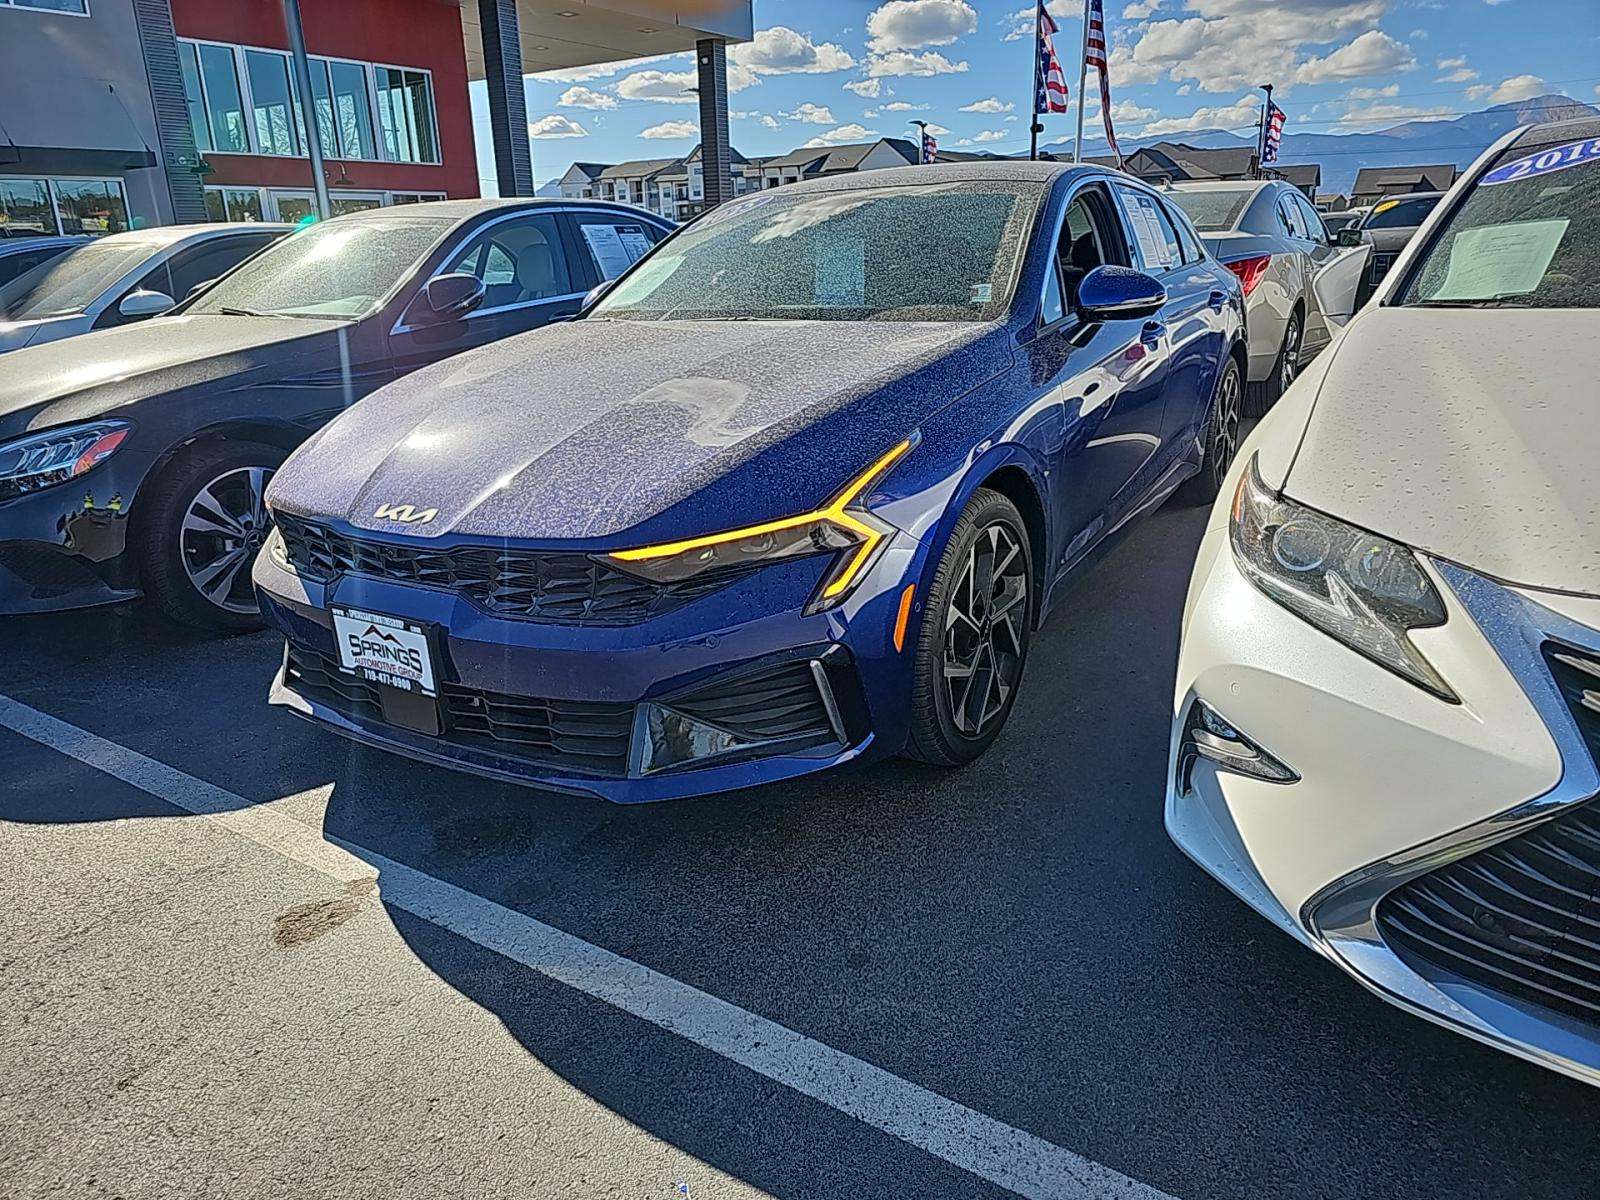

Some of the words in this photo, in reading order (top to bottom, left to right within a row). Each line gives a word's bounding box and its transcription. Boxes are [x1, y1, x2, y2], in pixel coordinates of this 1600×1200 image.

[349, 634, 422, 673] SPRINGS
[354, 658, 397, 674] AUTOMOTIVE
[399, 666, 423, 680] GROUP
